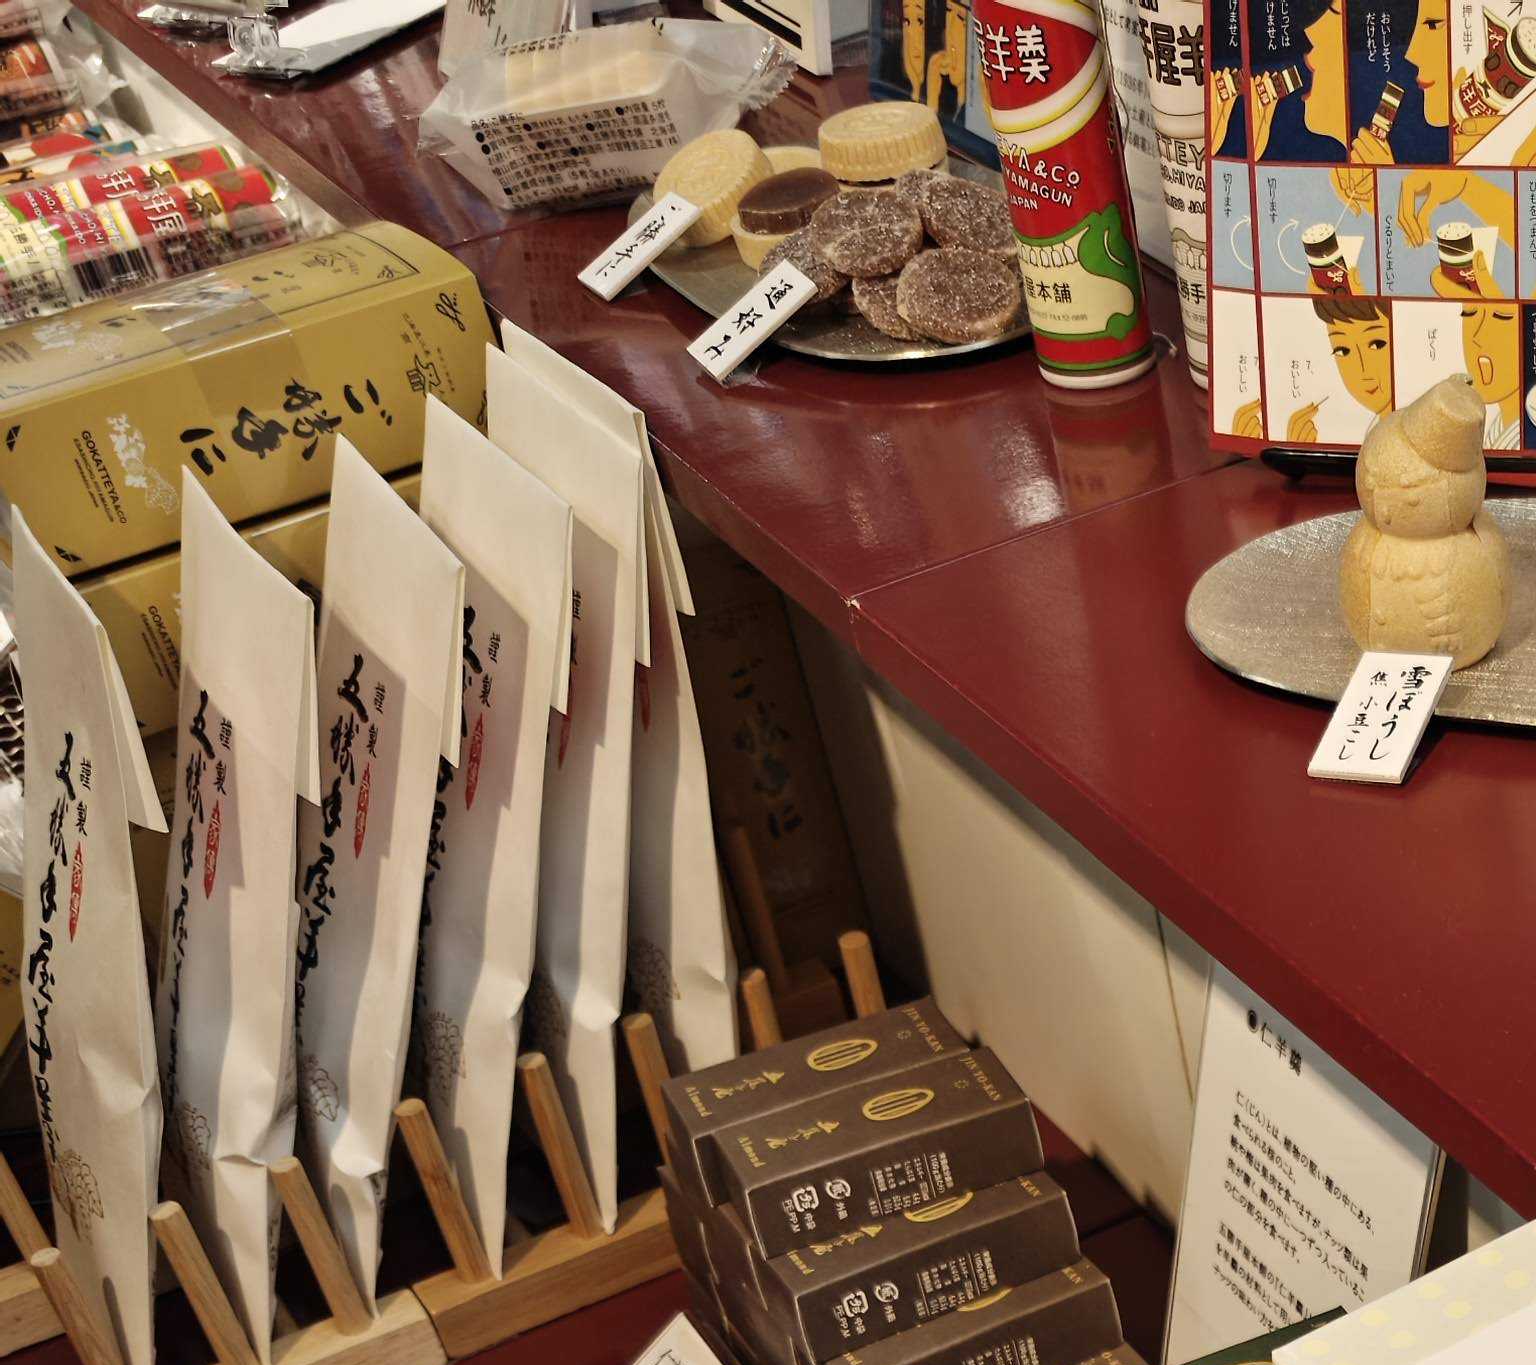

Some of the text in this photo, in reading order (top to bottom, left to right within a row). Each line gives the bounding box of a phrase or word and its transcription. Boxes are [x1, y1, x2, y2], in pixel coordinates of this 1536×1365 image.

[1366, 12, 1376, 63] だけれど
[1381, 12, 1391, 73] おいしそう
[1369, 666, 1432, 761] 雪ぼうし
